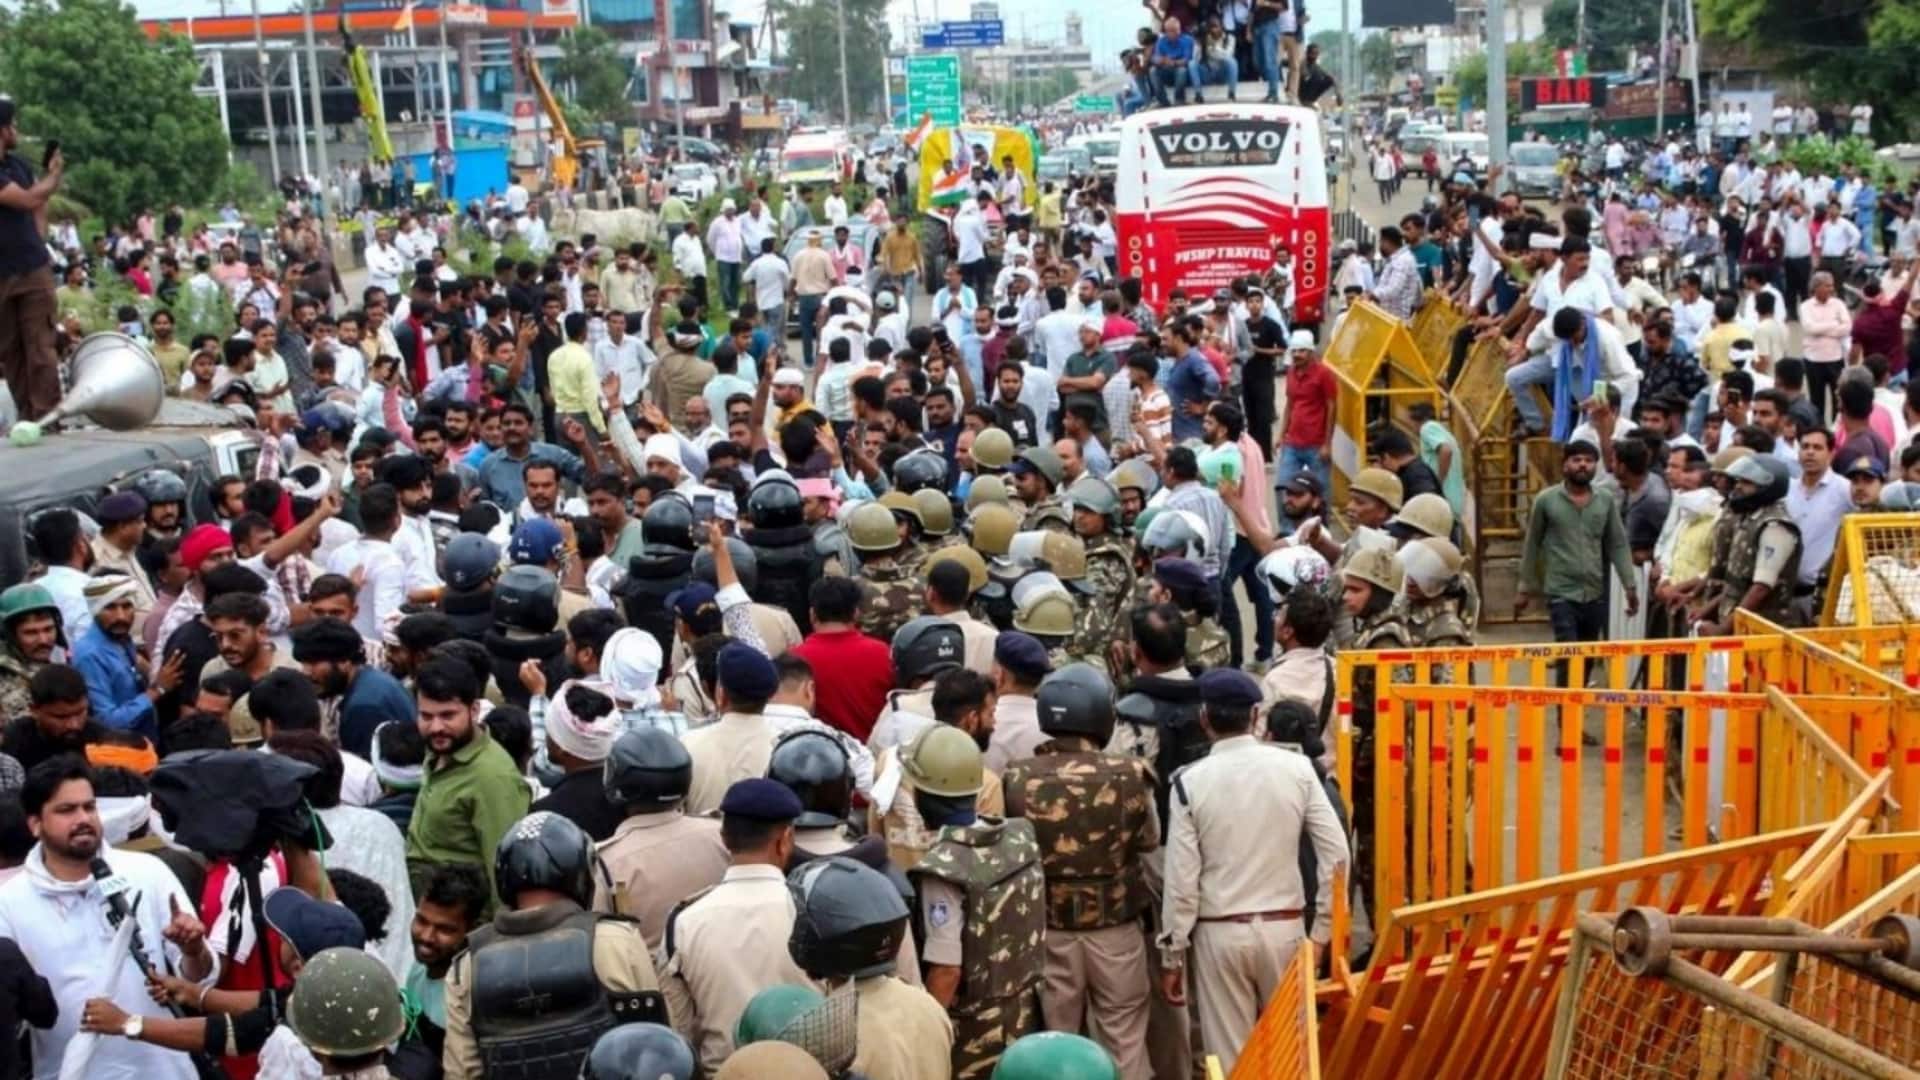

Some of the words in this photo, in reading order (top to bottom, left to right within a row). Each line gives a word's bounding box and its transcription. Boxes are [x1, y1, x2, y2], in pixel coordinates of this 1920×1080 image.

[1535, 78, 1593, 103] BAR
[1160, 131, 1281, 153] VOLVO
[1522, 647, 1552, 657] PWD
[1555, 646, 1584, 656] JAIL
[1594, 693, 1627, 703] PWD
[1632, 694, 1664, 706] JAIL
